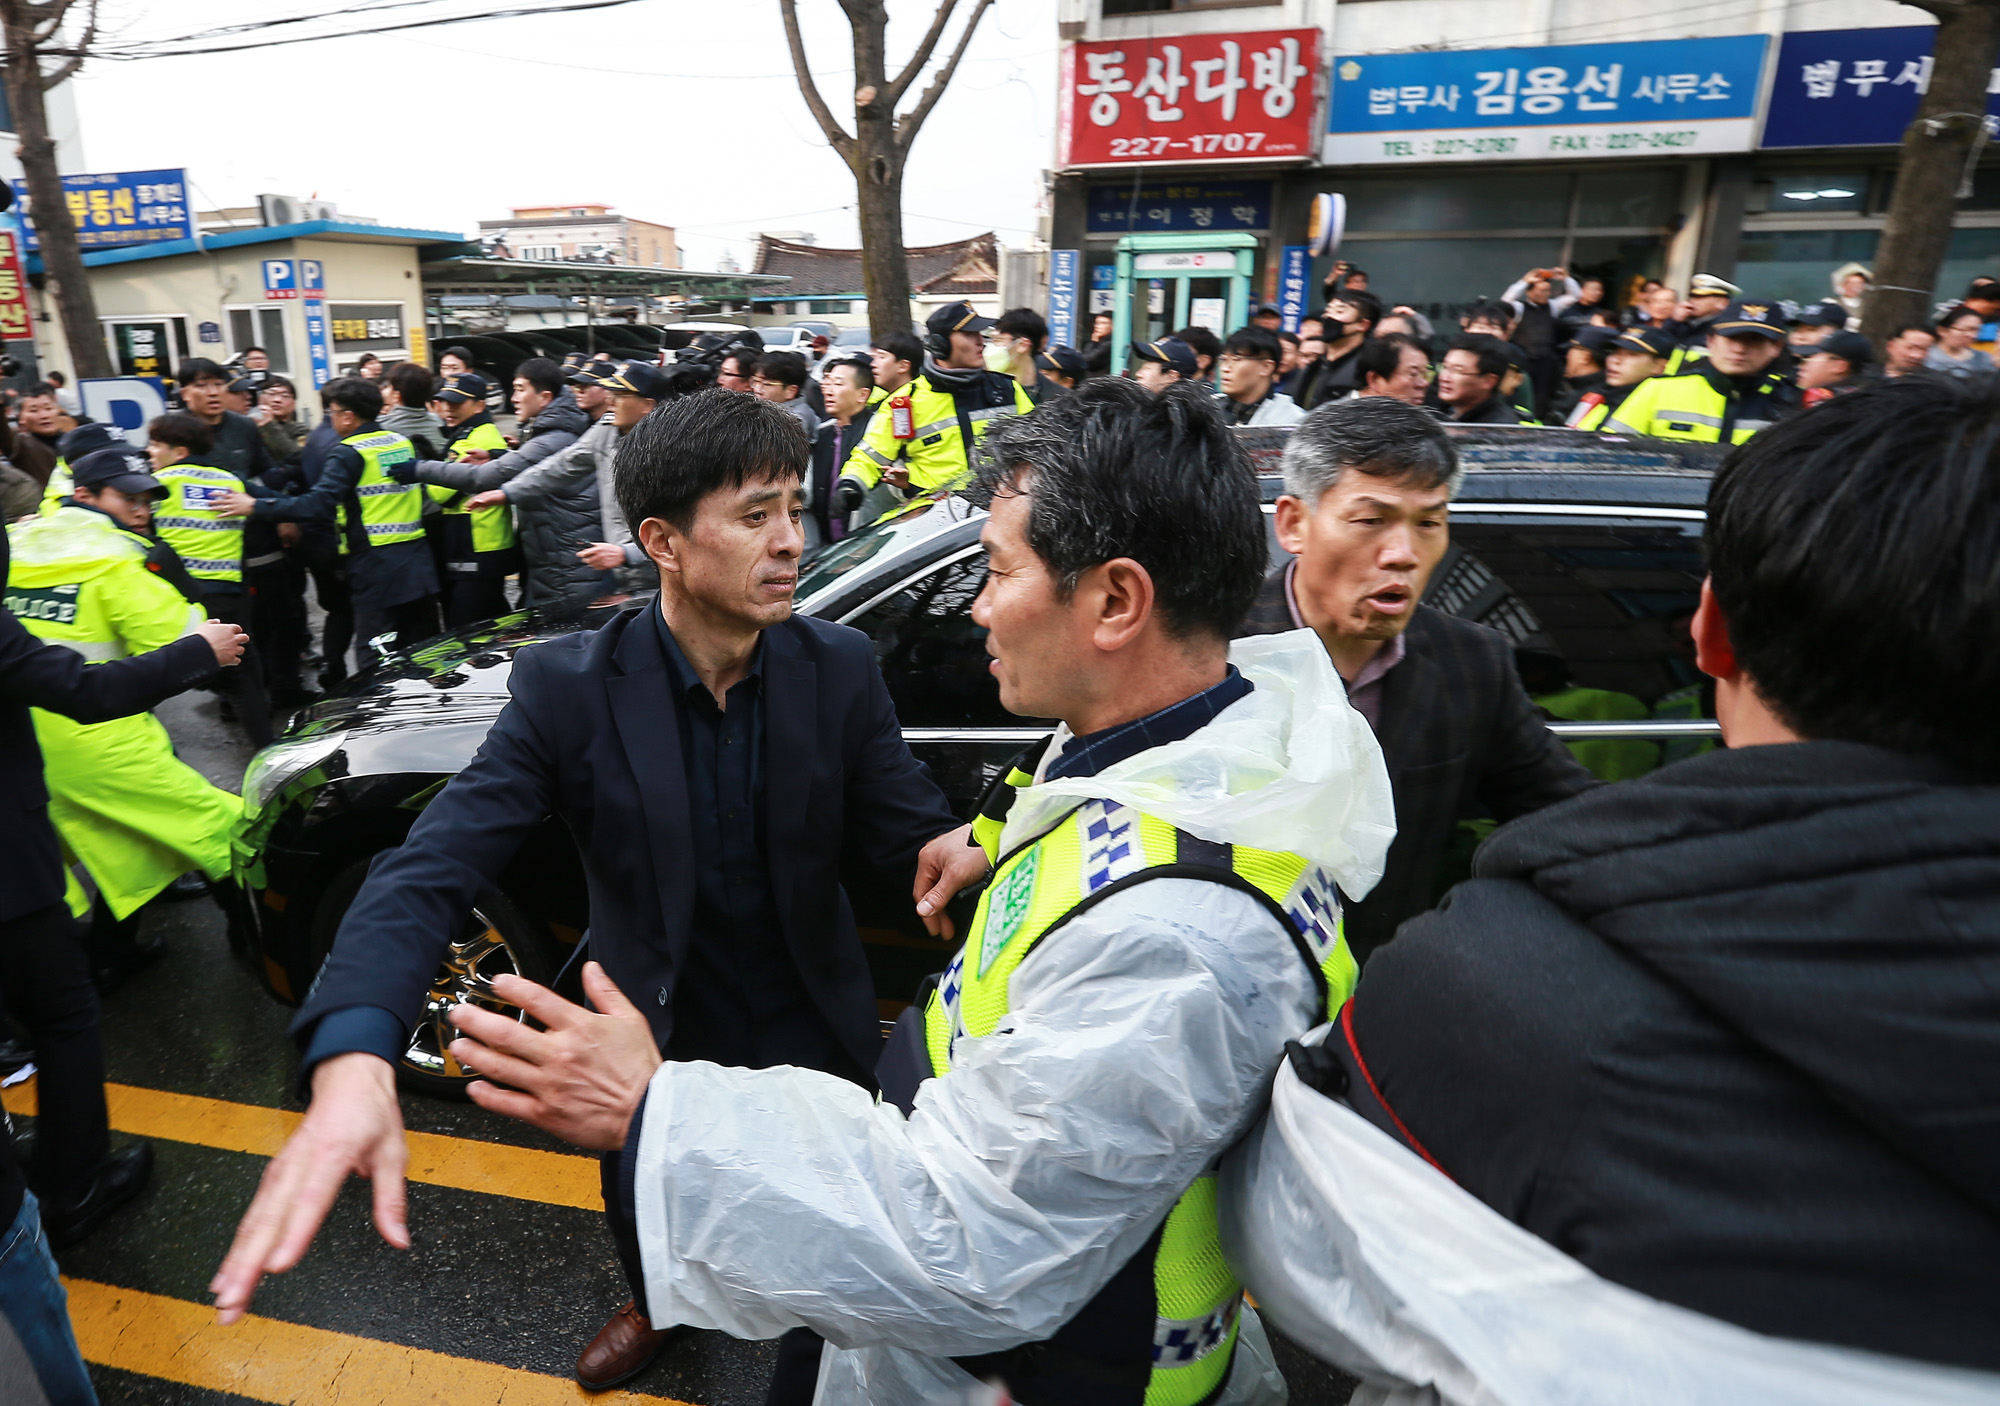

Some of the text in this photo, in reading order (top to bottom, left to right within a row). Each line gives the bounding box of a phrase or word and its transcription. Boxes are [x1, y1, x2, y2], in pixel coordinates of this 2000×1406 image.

[1076, 37, 1308, 127] 동산다방
[1368, 63, 1732, 115] 법무사 김용선 사무소
[1109, 132, 1266, 157] 227-1707
[1549, 135, 1591, 150] FAX
[64, 187, 136, 228] 부동산
[265, 261, 290, 288] P
[303, 261, 320, 287] P
[2, 596, 77, 622] OLICE
